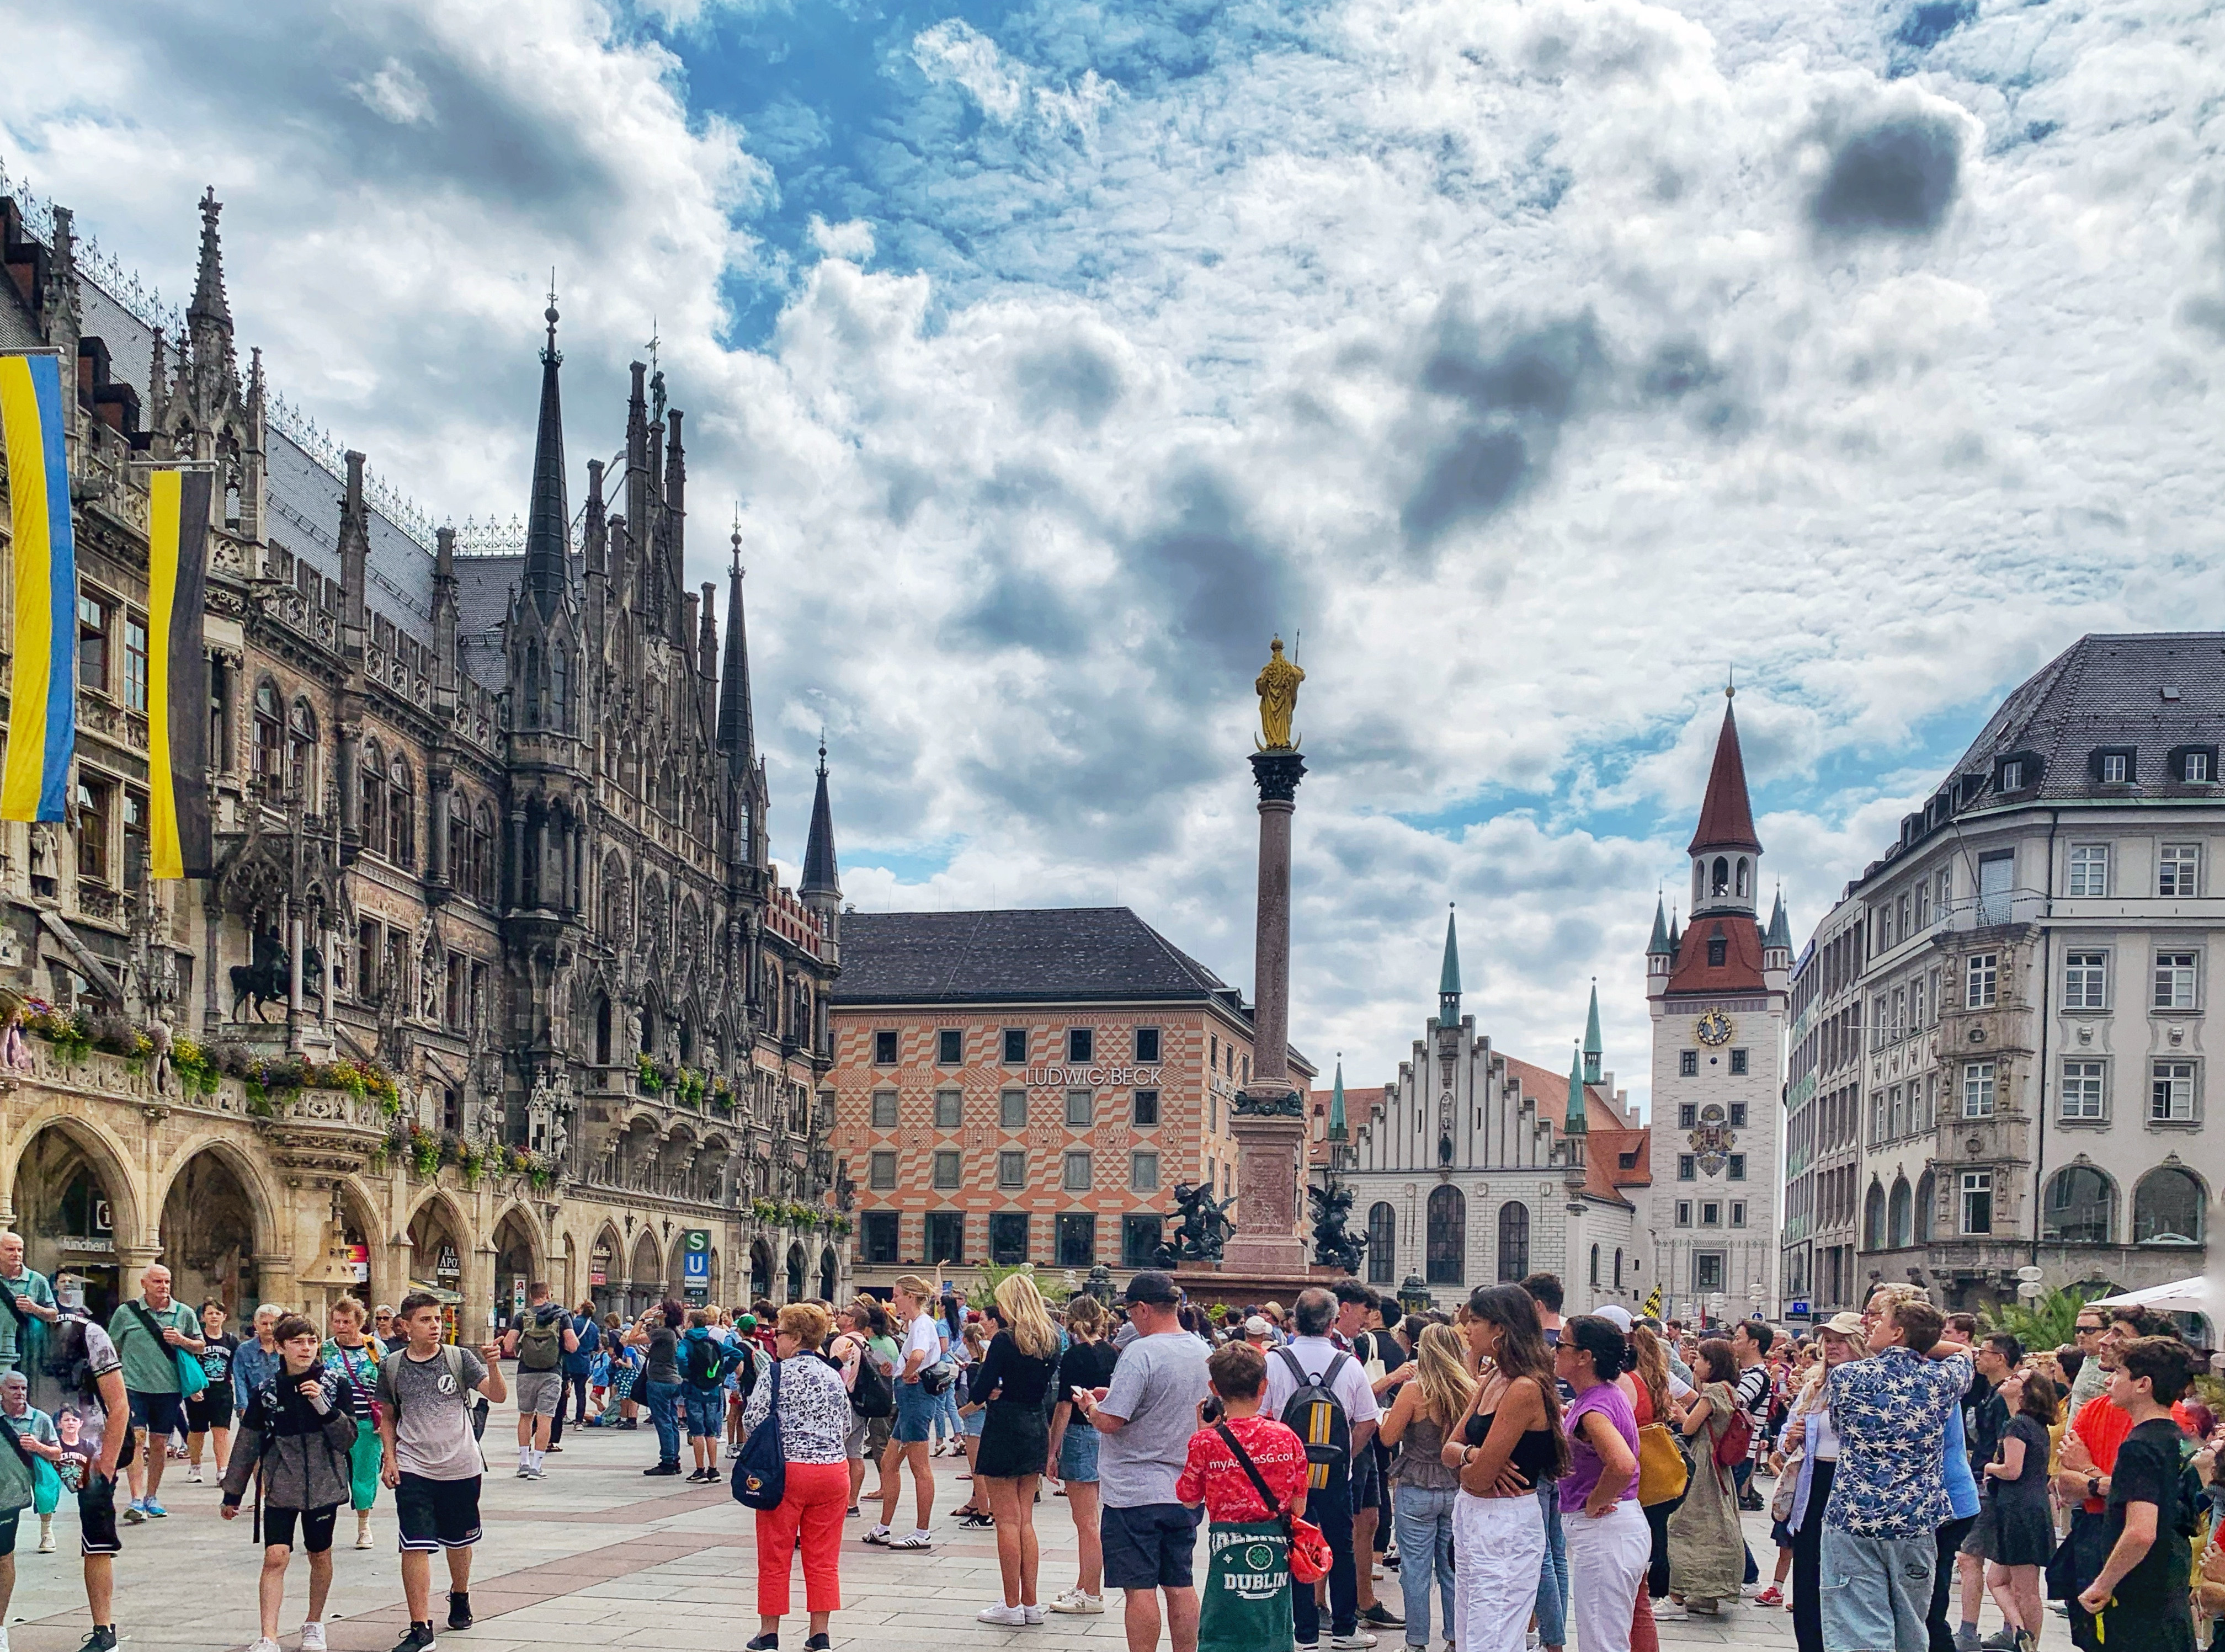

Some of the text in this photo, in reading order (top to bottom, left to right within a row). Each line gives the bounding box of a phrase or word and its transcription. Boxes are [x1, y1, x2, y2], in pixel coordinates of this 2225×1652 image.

[1025, 1067, 1163, 1086] LUDWIG BECK
[690, 1232, 704, 1250] S
[689, 1255, 703, 1273] U
[1224, 1572, 1289, 1590] DUBLIN
